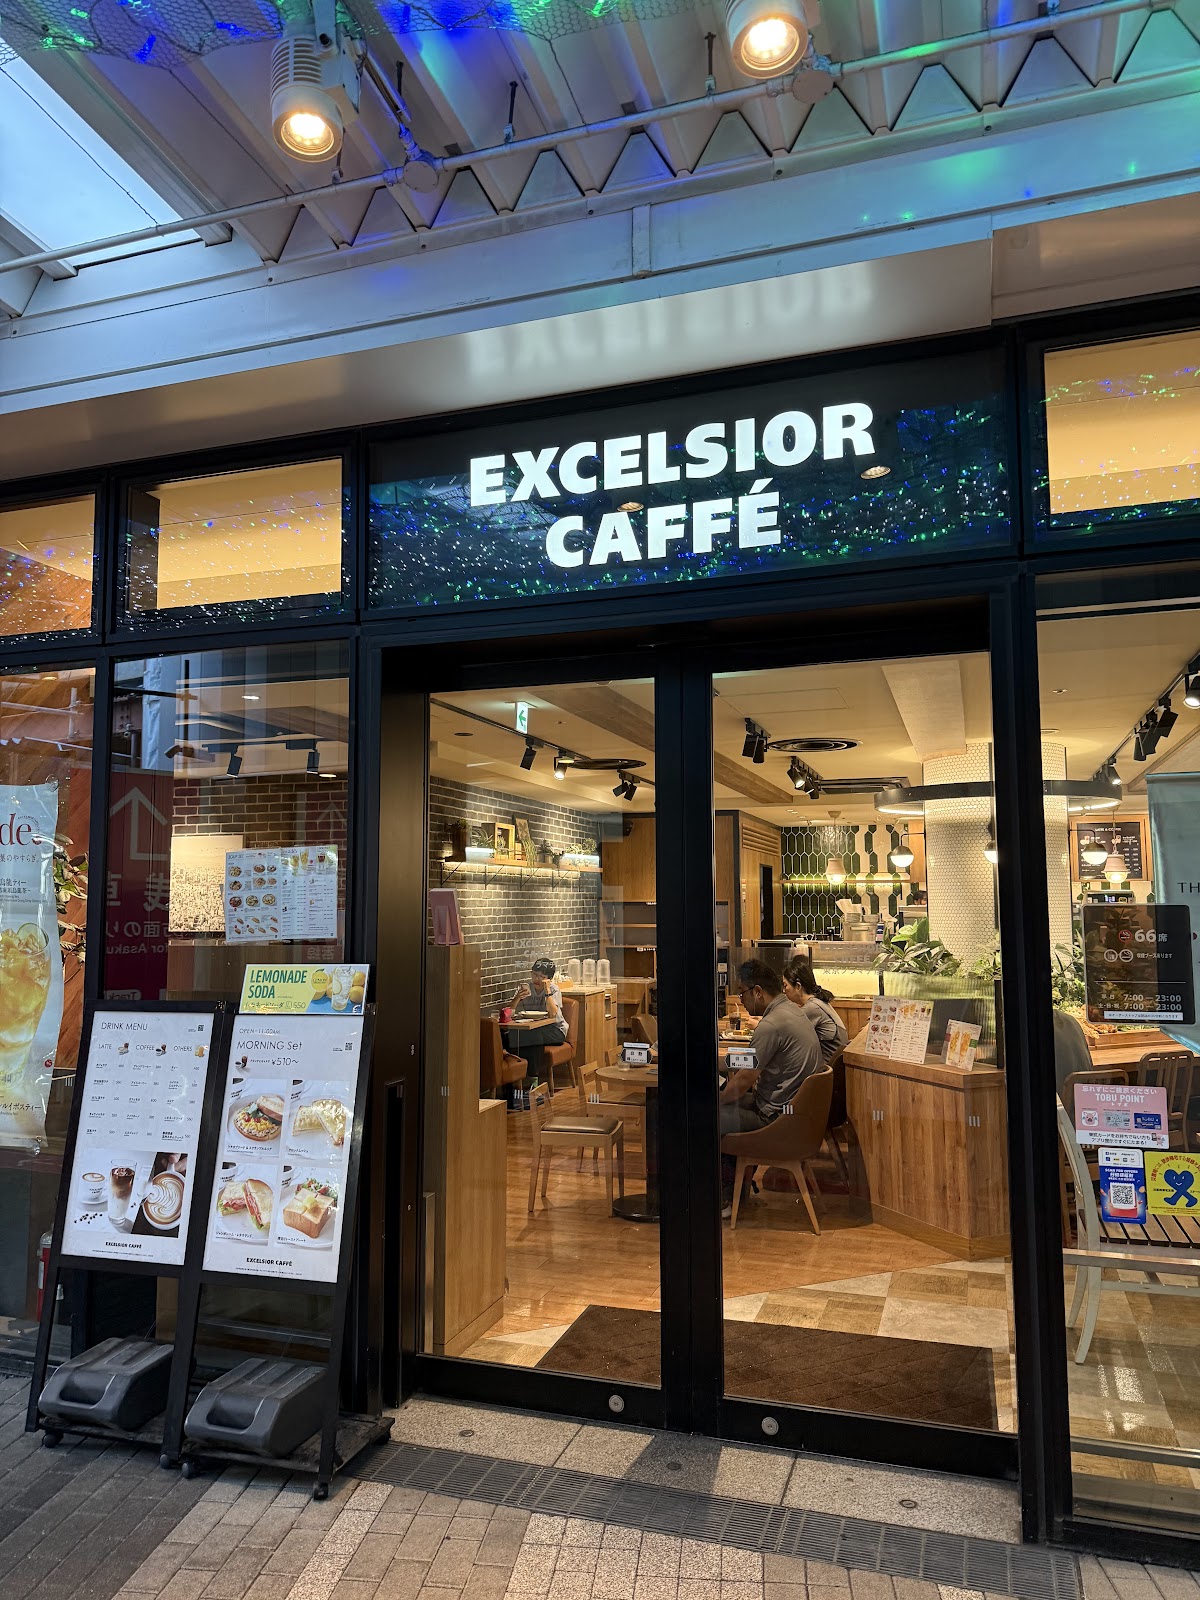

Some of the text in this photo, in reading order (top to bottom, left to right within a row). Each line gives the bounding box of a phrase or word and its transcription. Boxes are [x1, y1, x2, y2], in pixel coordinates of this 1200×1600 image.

[469, 402, 875, 507] EXCELSIOR
[545, 478, 781, 568] CAFFÉ
[250, 969, 308, 984] LEMONADE
[247, 985, 276, 999] SODA
[1123, 994, 1144, 1002] 7:00
[1155, 994, 1182, 1003] 23:00
[1123, 1002, 1144, 1010] 7:00
[1155, 1003, 1182, 1011] 23:00
[101, 1022, 148, 1031] DRINK MENU
[236, 1040, 303, 1051] MORNING Set
[1095, 1094, 1145, 1103] TOBU POINT
[246, 1257, 275, 1265] EXCELSIOR
